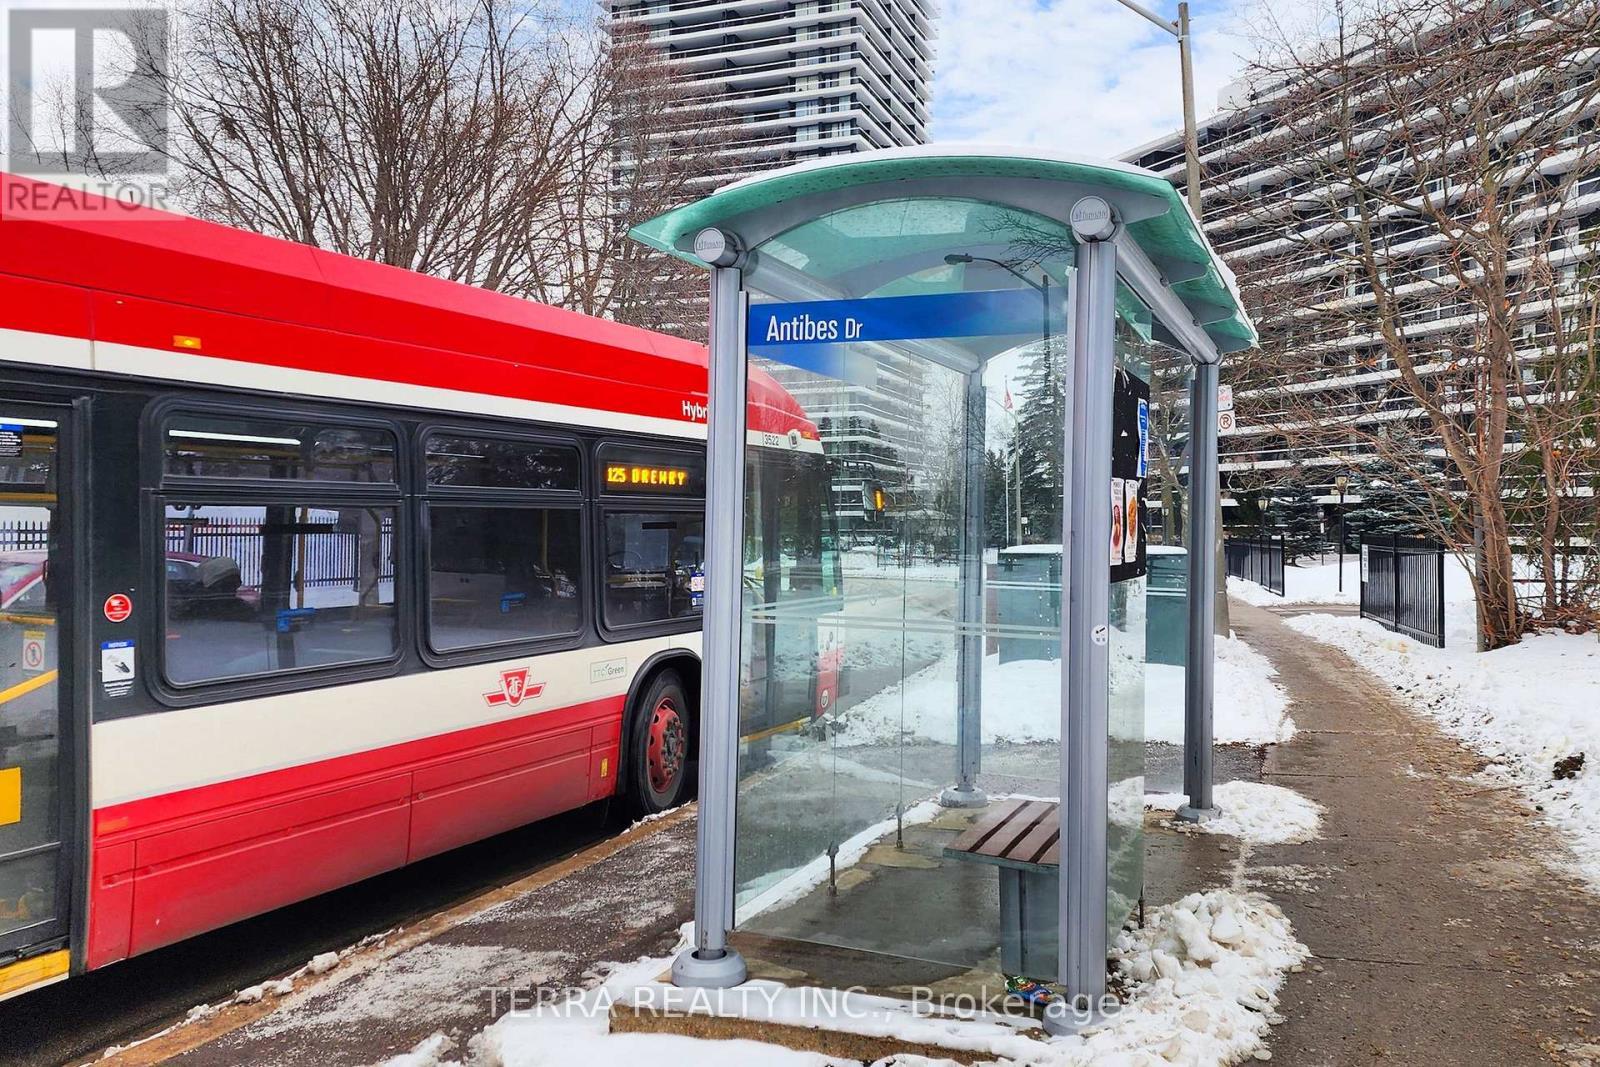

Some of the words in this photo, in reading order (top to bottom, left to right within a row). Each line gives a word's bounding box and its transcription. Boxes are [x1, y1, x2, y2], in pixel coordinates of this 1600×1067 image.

[766, 313, 839, 342] Antibes
[844, 317, 863, 339] Dr
[681, 400, 708, 421] Hybr
[764, 434, 780, 446] 3522
[607, 467, 626, 483] 125
